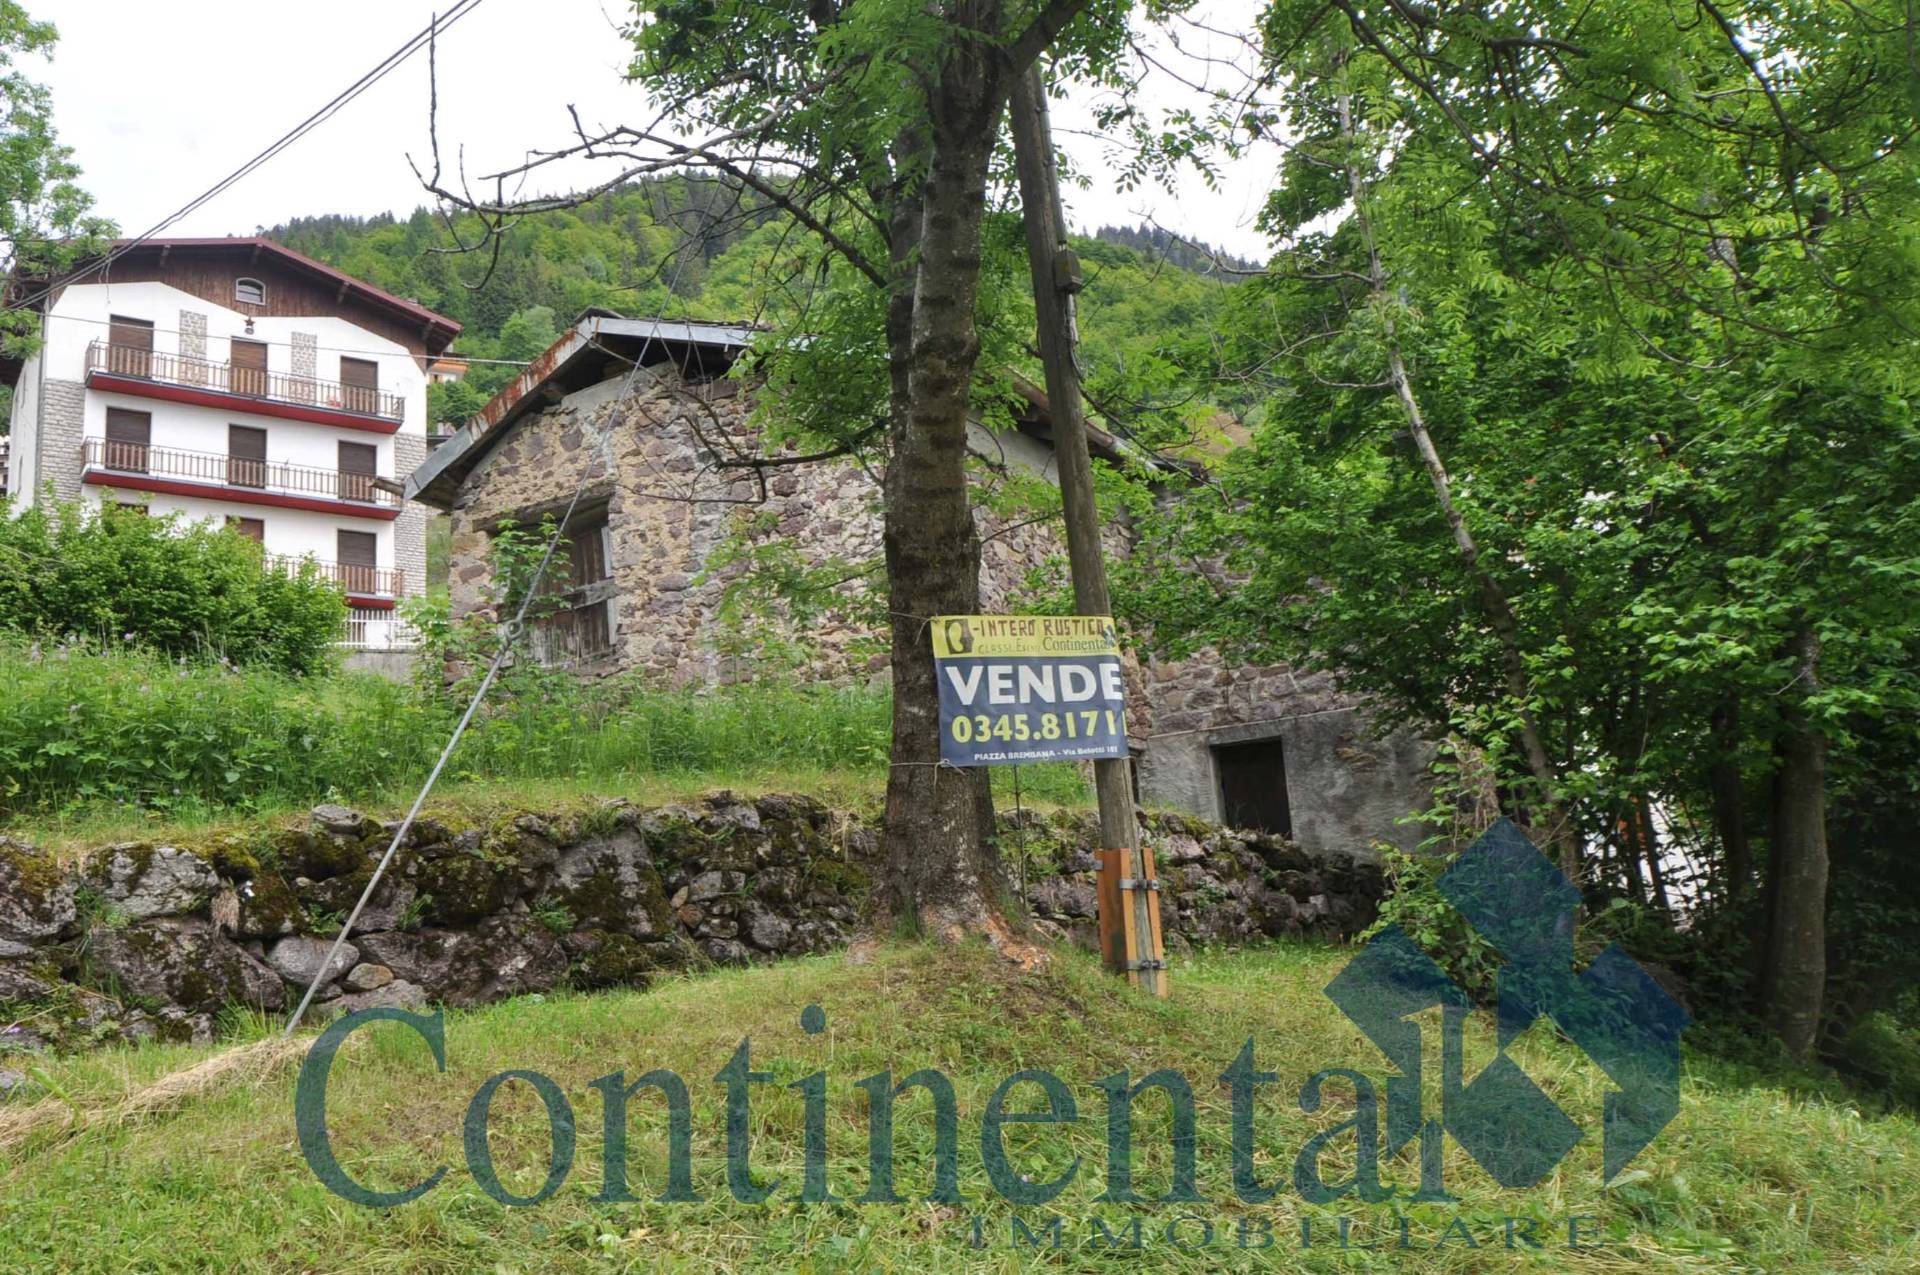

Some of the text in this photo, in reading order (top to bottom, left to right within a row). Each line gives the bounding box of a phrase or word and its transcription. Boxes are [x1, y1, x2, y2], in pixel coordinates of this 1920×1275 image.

[1043, 617, 1105, 636] RUSTICO
[945, 663, 1123, 706] VENDE
[974, 752, 1007, 761] PIAZZA
